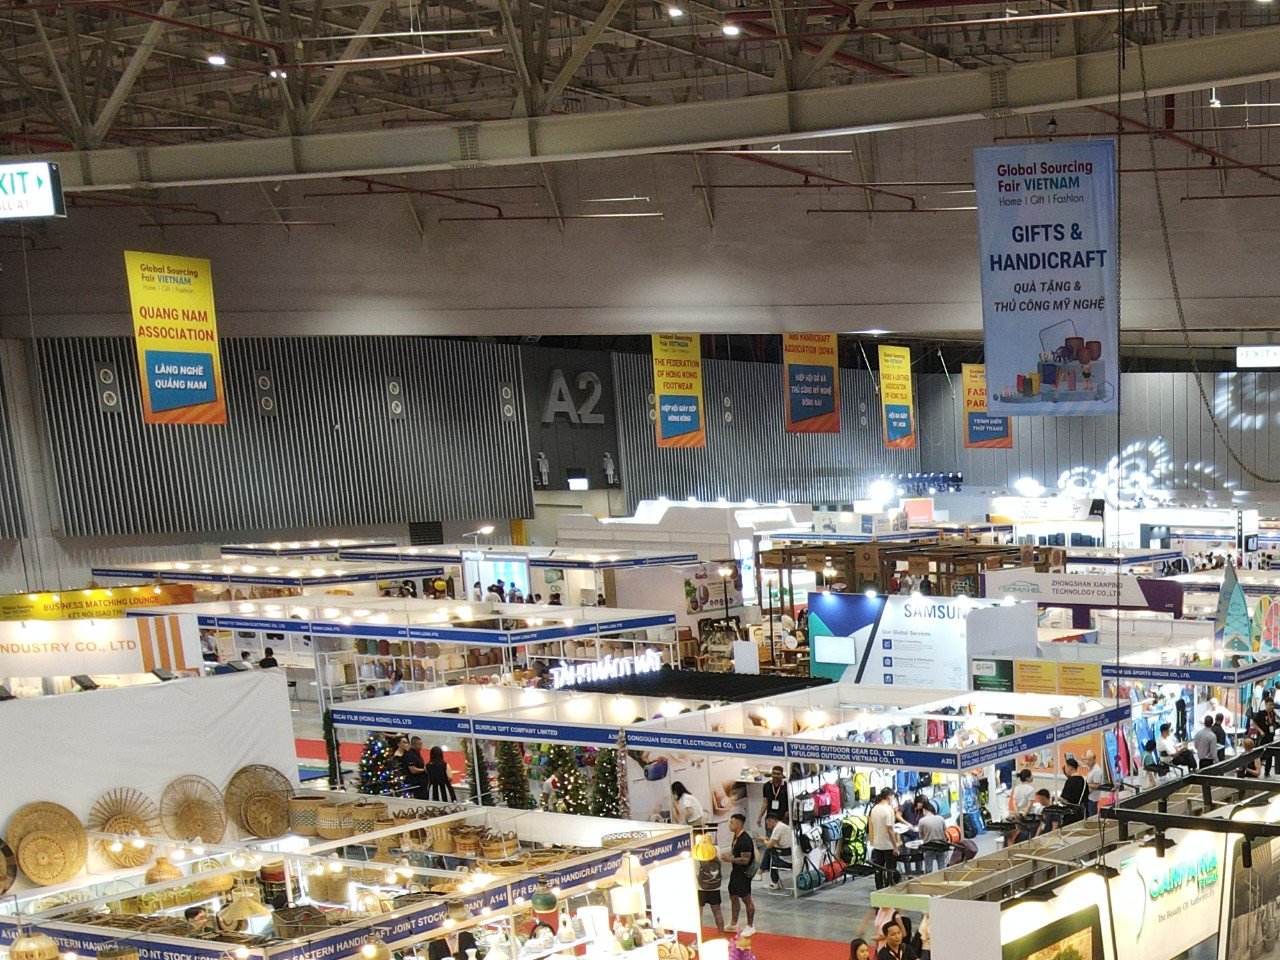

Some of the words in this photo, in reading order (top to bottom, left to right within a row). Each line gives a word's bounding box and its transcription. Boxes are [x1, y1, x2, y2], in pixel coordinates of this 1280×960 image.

[997, 162, 1037, 177] Global
[1040, 160, 1093, 175] Sourcing
[998, 180, 1020, 192] Fair
[1024, 176, 1080, 191] VIETNAM
[1000, 197, 1021, 206] Home
[1030, 195, 1045, 205] Gift
[1053, 194, 1084, 204] Fashion
[1012, 224, 1065, 243] GIFTS
[1071, 223, 1082, 240] &
[990, 250, 1107, 271] HANDICRAFT
[140, 264, 165, 274] Global
[167, 266, 198, 278] Sourcing
[142, 274, 155, 282] Fair
[157, 276, 191, 285] VIETNAM
[1014, 280, 1036, 294] QUÀ
[1041, 280, 1070, 294] TẶNG
[994, 300, 1015, 312] THỦ
[1019, 299, 1050, 311] CÔNG
[1053, 299, 1071, 310] MỸ
[1073, 297, 1105, 311] NGHỆ
[140, 305, 178, 320] QUANG
[182, 309, 208, 322] NAM
[138, 325, 214, 341] ASSOCIATION
[785, 345, 816, 354] ASSOCIATION
[155, 363, 178, 374] LÀNG
[655, 358, 665, 366] THE
[666, 359, 699, 367] FEDERATION
[665, 370, 681, 378] HONG
[187, 380, 207, 389] NAM
[663, 382, 693, 390] FOOTWEAR
[542, 369, 606, 425] A2
[1051, 580, 1092, 588] ZHONGSHAN
[43, 600, 84, 612] BUSINESS
[85, 598, 128, 607] MATCHING
[129, 597, 159, 605] LOUNGE
[110, 640, 136, 650] LTD
[510, 726, 535, 734] COMPANY
[536, 728, 558, 736] LIMITED
[627, 735, 659, 744] DONGGUAN
[682, 739, 722, 748] ELECTRONICS
[735, 742, 747, 750] LTD
[561, 864, 602, 884] HANDICRAFT
[604, 859, 622, 871] JOINT
[645, 845, 672, 859] COMPANY
[677, 839, 690, 850] A141
[392, 920, 416, 935] JOINT
[417, 913, 445, 927] STOCK
[490, 894, 507, 905] A141
